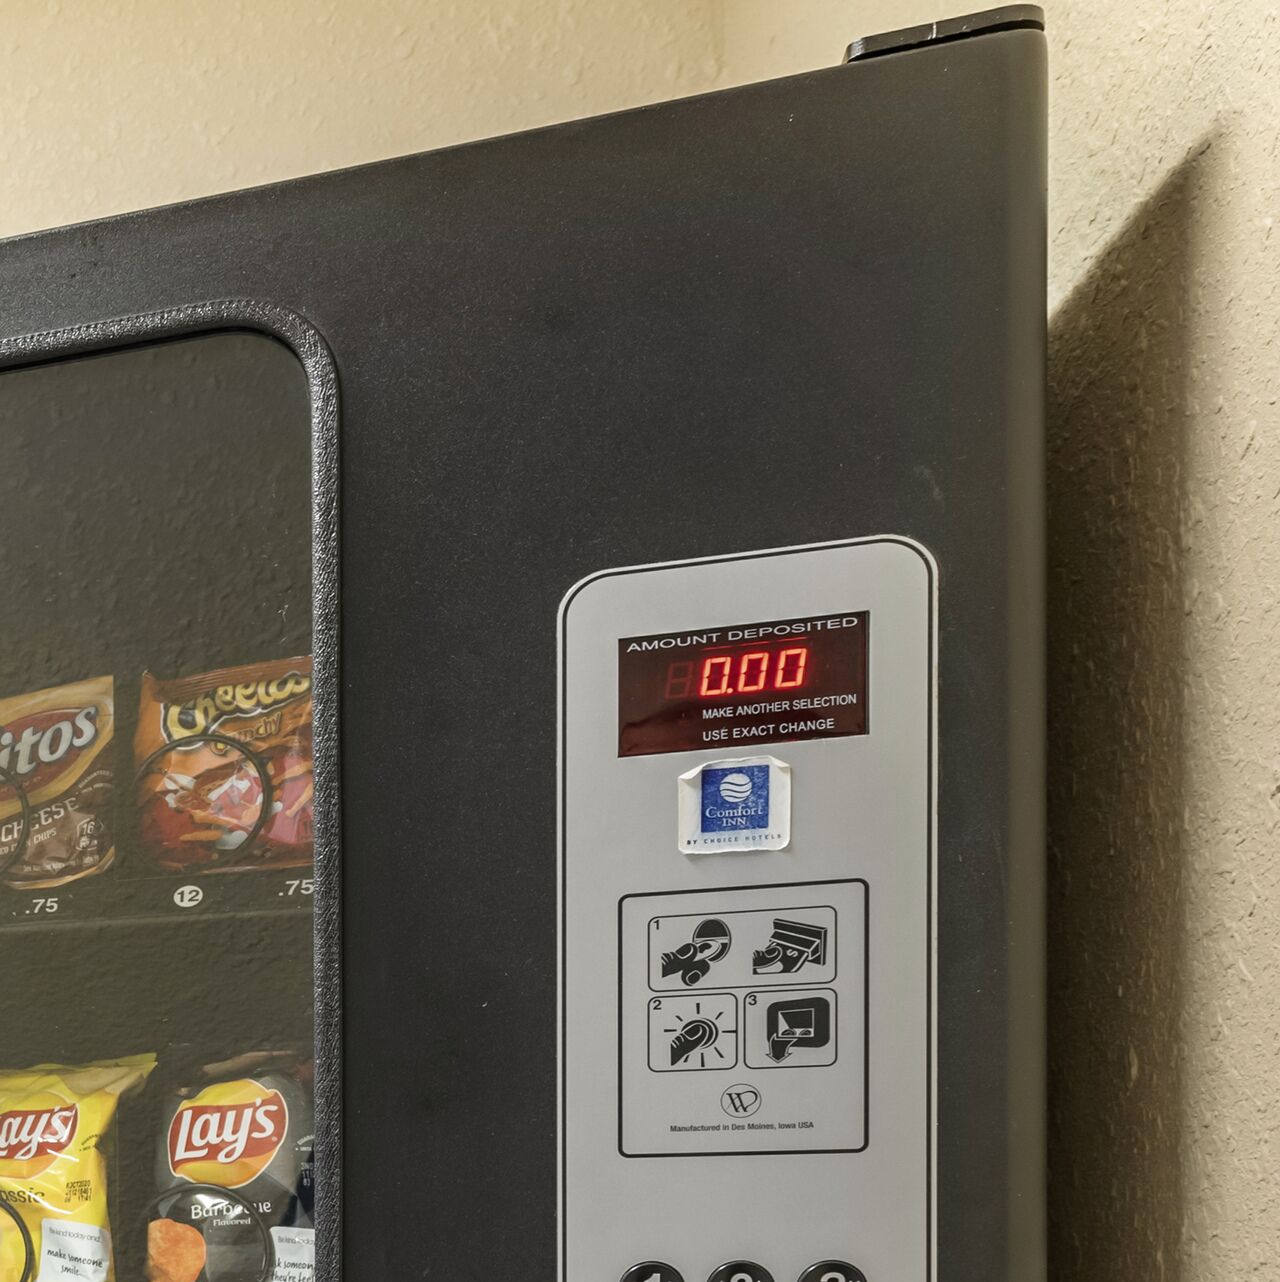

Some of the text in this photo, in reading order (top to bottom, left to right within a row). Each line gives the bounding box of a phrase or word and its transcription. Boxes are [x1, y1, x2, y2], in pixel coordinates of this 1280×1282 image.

[625, 616, 859, 654] AMOUNT DEPOSITED
[699, 647, 809, 697] 0.00
[702, 693, 857, 720] MAKE ANOTHER SELECTION
[702, 718, 835, 742] USE EXACT CHANGE
[704, 803, 764, 820] Comfort
[720, 816, 748, 828] INN
[703, 835, 739, 845] CHOICE
[744, 833, 783, 842] HOTELS
[24, 897, 59, 915] .75
[652, 918, 661, 931] 1
[652, 999, 663, 1011] 2
[747, 994, 758, 1006] 3
[174, 1097, 279, 1163] Lay's
[669, 1121, 815, 1133] Manufactured in Des Moines, Iowa USA
